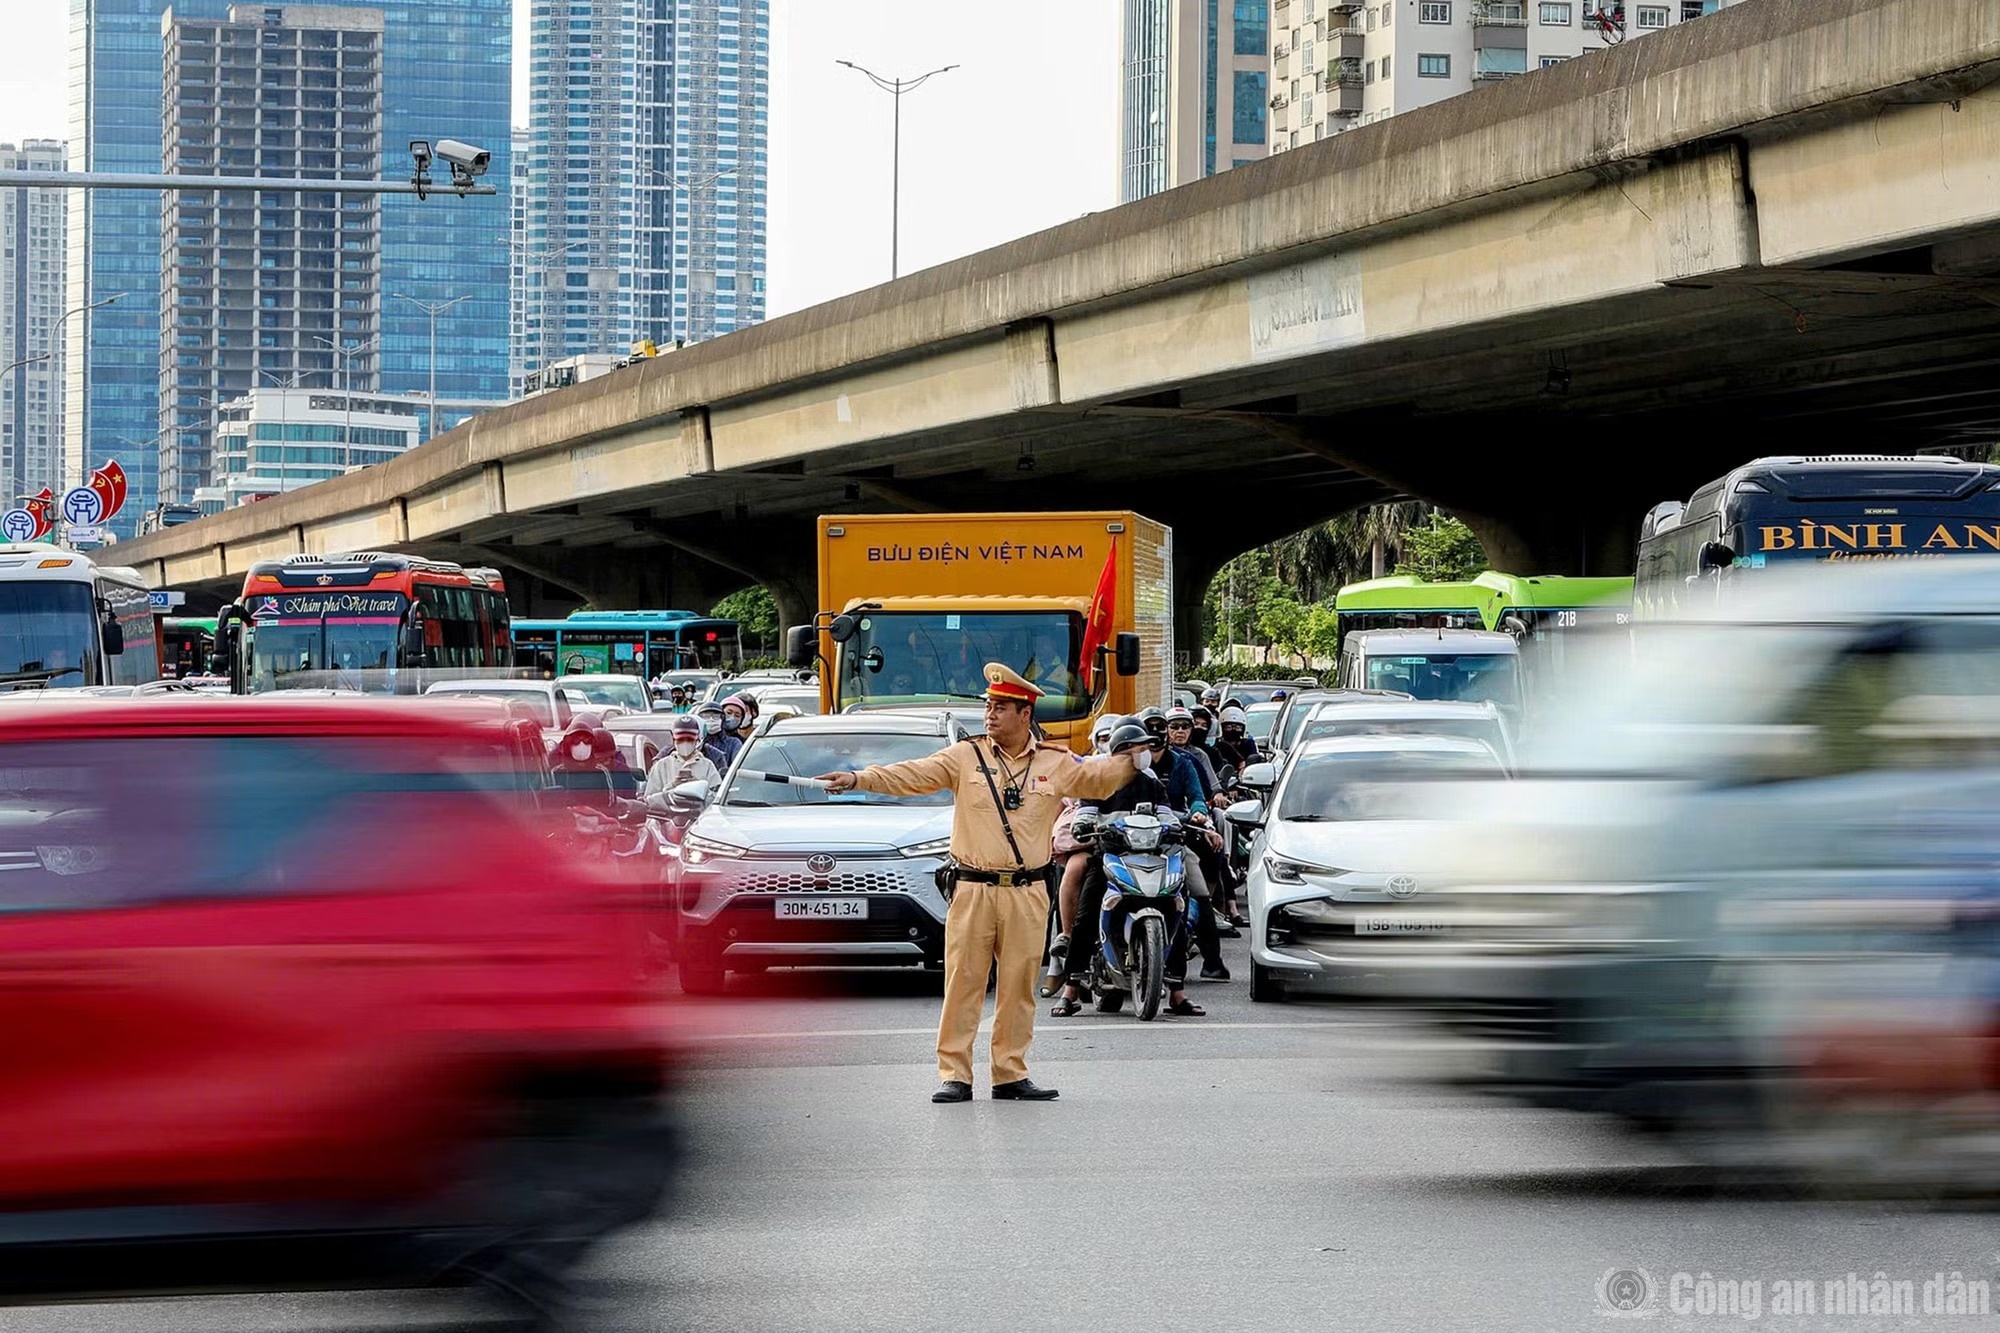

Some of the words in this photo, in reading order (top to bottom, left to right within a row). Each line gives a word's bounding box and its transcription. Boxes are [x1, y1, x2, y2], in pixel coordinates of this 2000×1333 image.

[1759, 519, 1906, 550] BÌNH
[1921, 524, 2000, 549] AN
[868, 544, 911, 561] BƯU
[918, 542, 969, 565] ĐIỆN
[978, 541, 1027, 564] VIỆT
[1033, 545, 1083, 559] NAM
[284, 596, 320, 613] Khám
[321, 596, 341, 618] phá
[341, 595, 366, 614] Việt
[369, 597, 398, 611] travel
[1558, 611, 1576, 627] 21B
